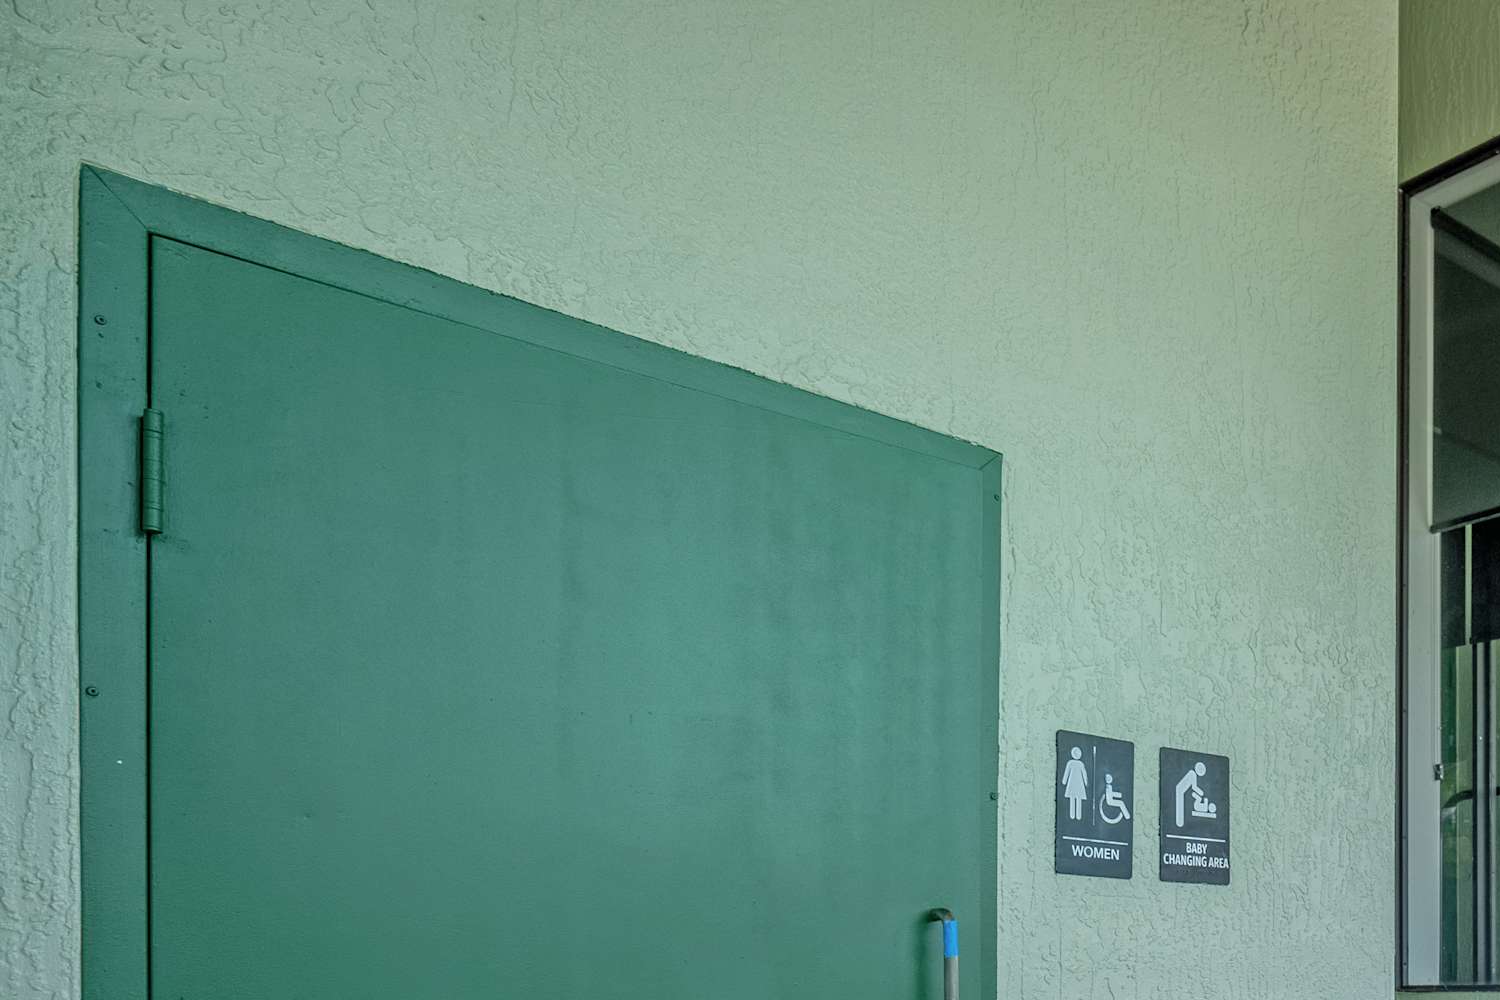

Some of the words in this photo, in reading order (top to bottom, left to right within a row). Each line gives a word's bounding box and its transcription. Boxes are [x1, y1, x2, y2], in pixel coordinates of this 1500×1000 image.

[1071, 844, 1120, 861] WOMEN
[1185, 842, 1208, 855] BABY
[1163, 853, 1208, 868] CHANGING
[1208, 857, 1229, 869] AREA
